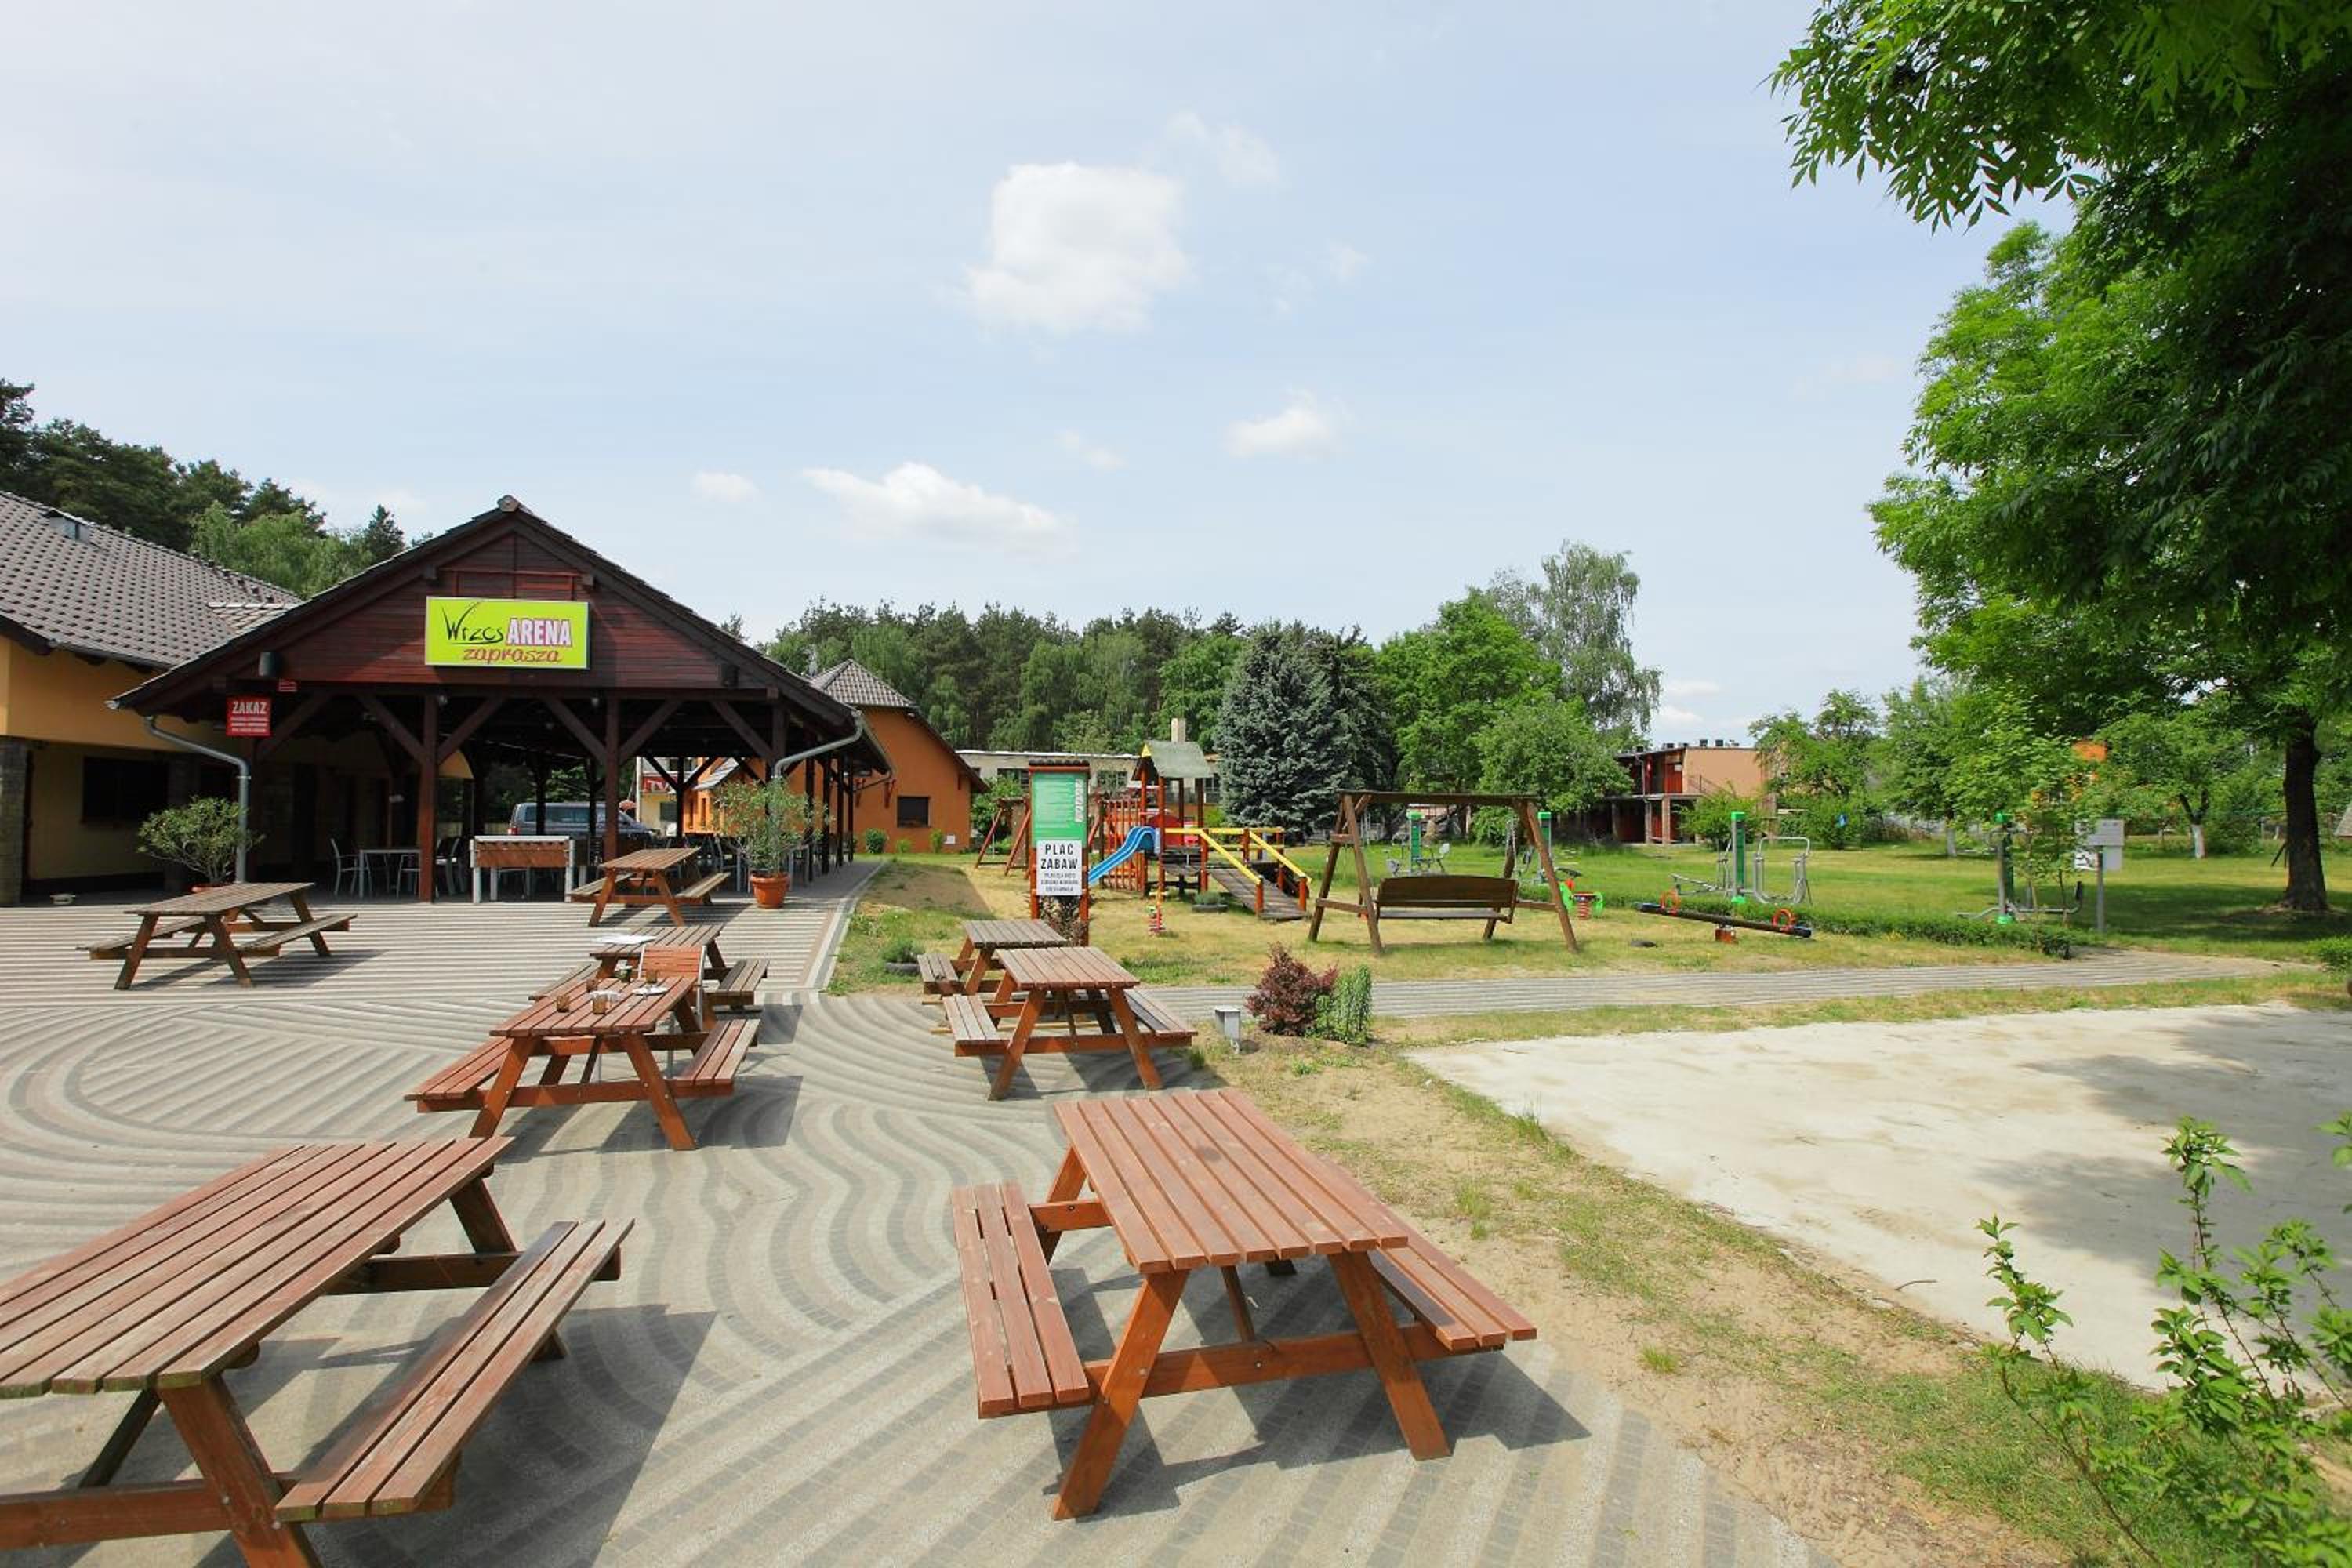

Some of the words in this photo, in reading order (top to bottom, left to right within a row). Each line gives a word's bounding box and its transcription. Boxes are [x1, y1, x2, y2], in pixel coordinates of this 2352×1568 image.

[506, 618, 572, 647] ARENA
[463, 648, 563, 664] zaprasza
[231, 701, 267, 714] ZAKAZ
[1045, 844, 1073, 855] PLAC
[1040, 858, 1078, 869] ZABAW
